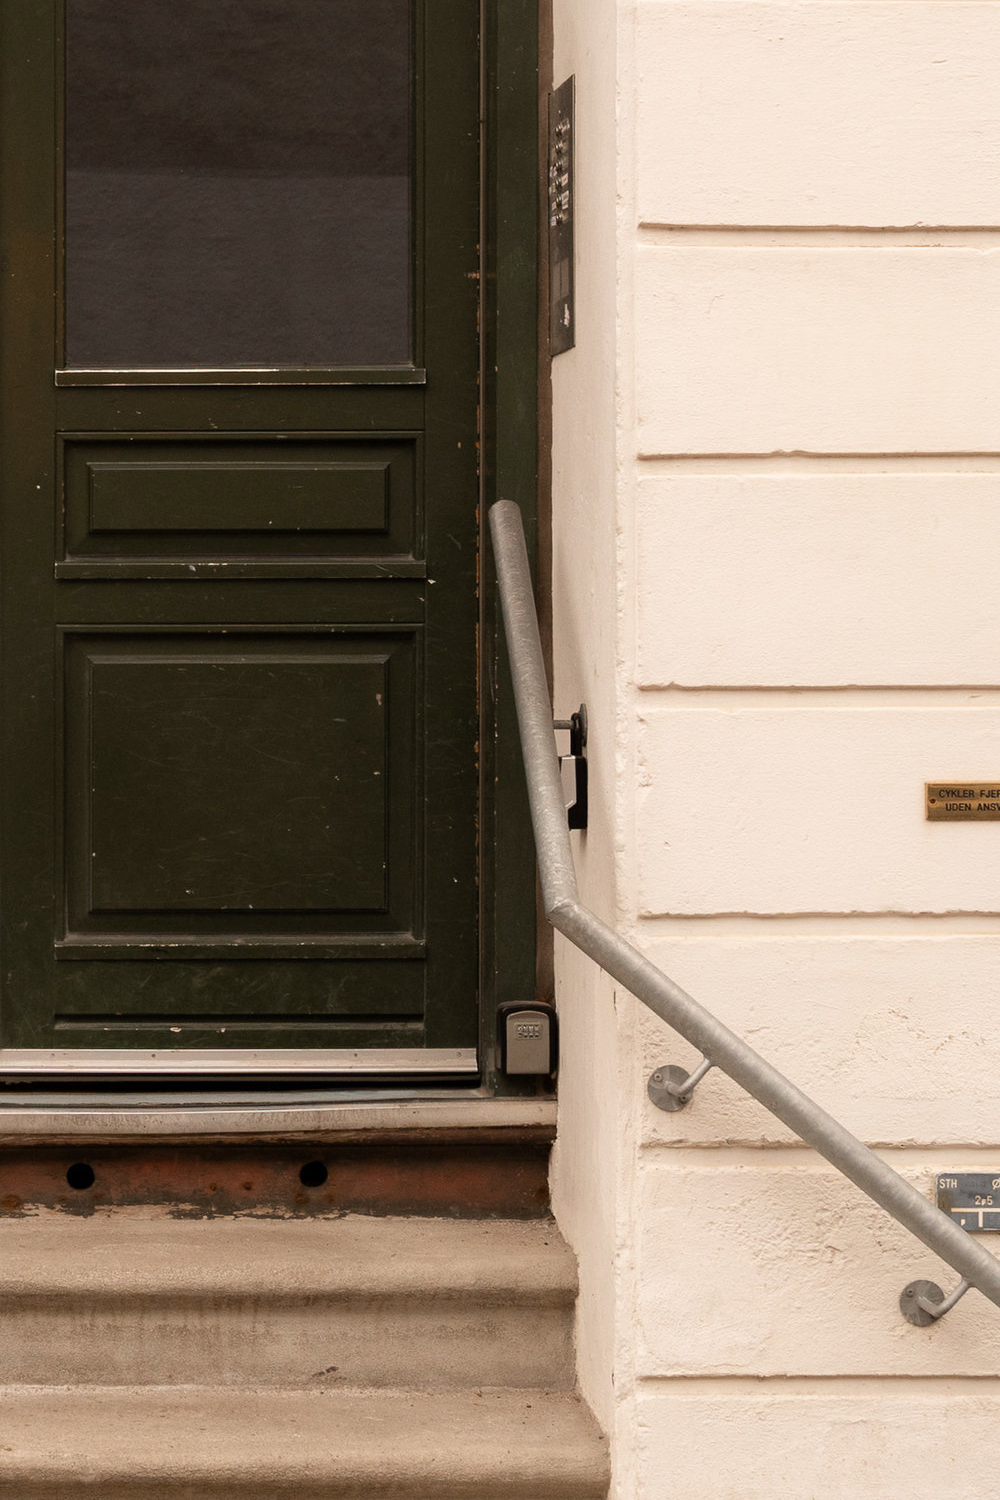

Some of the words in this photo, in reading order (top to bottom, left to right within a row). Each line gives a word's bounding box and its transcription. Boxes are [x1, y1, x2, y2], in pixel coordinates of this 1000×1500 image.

[938, 789, 975, 798] CYKLER
[945, 803, 972, 812] UDEN
[940, 1179, 957, 1189] STH
